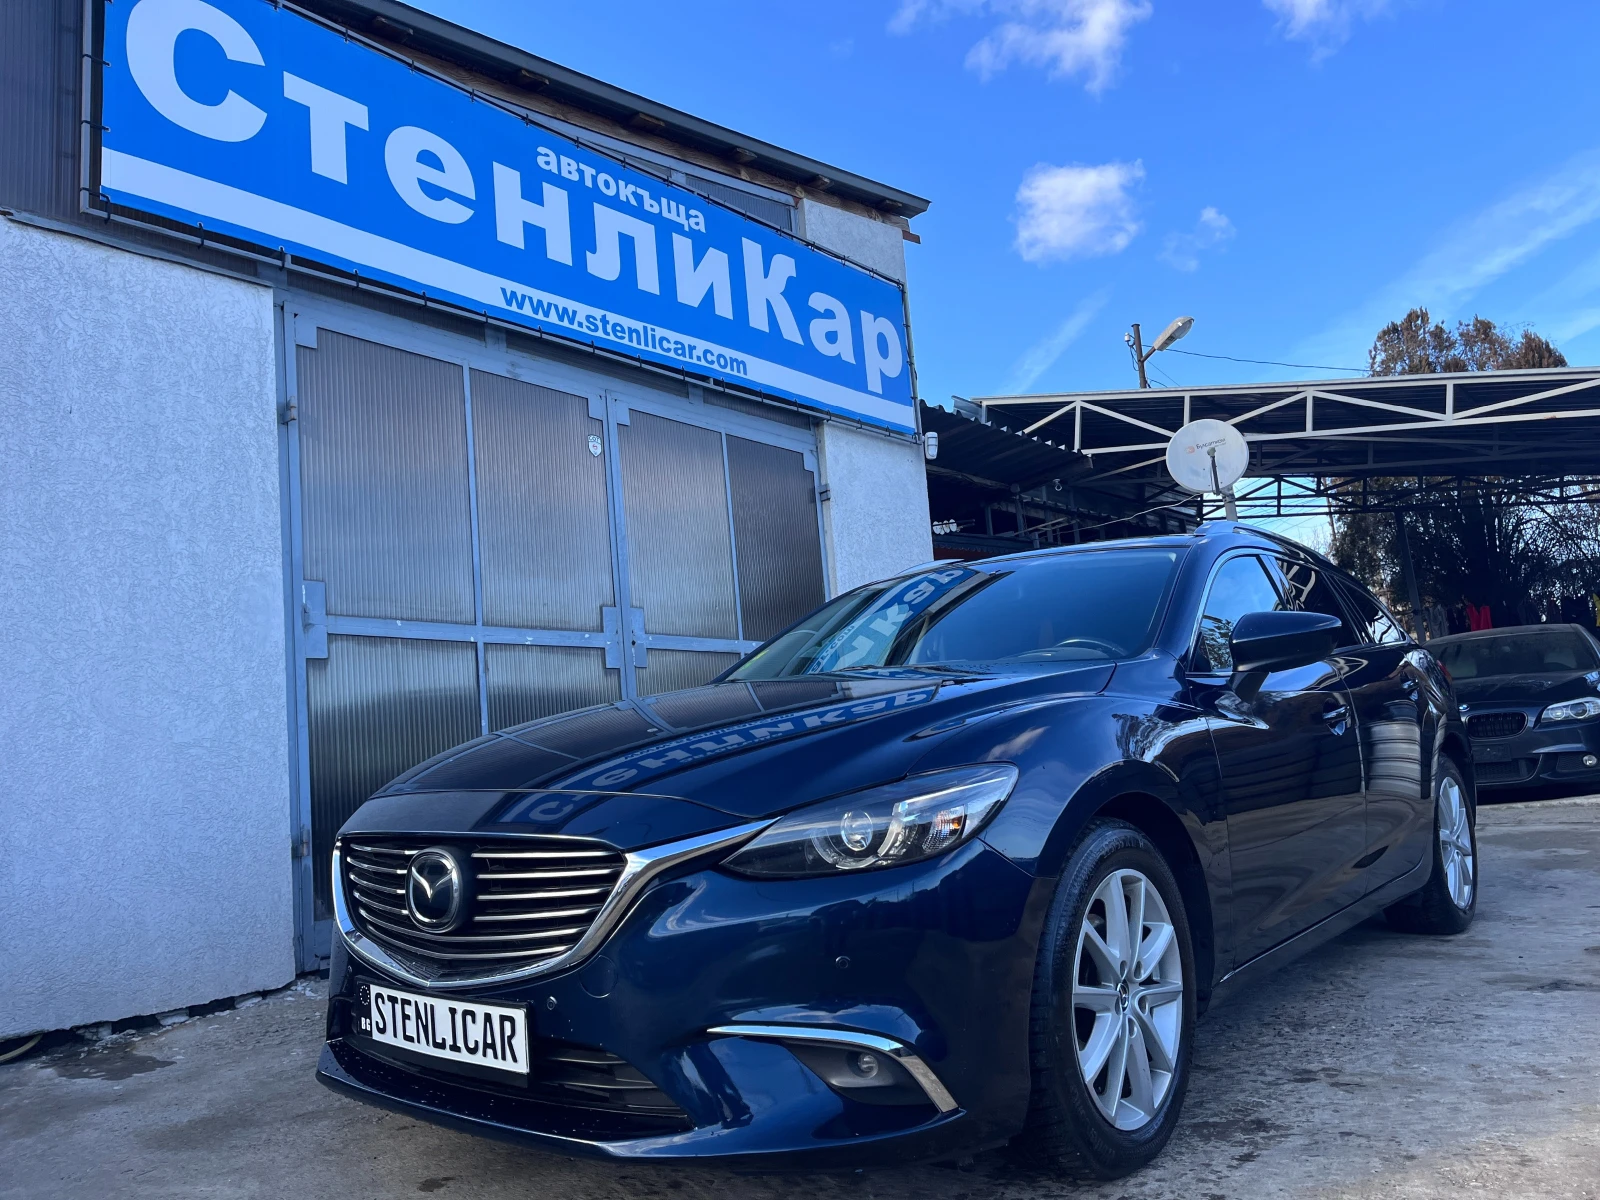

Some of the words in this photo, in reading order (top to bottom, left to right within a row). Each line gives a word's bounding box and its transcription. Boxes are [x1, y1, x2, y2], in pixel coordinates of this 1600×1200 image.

[126, 0, 903, 394] СтенлиКар
[536, 146, 706, 232] автокъща
[500, 286, 748, 377] www.stenlicar.com
[361, 1016, 371, 1031] BG
[374, 992, 518, 1063] STENLICAR
